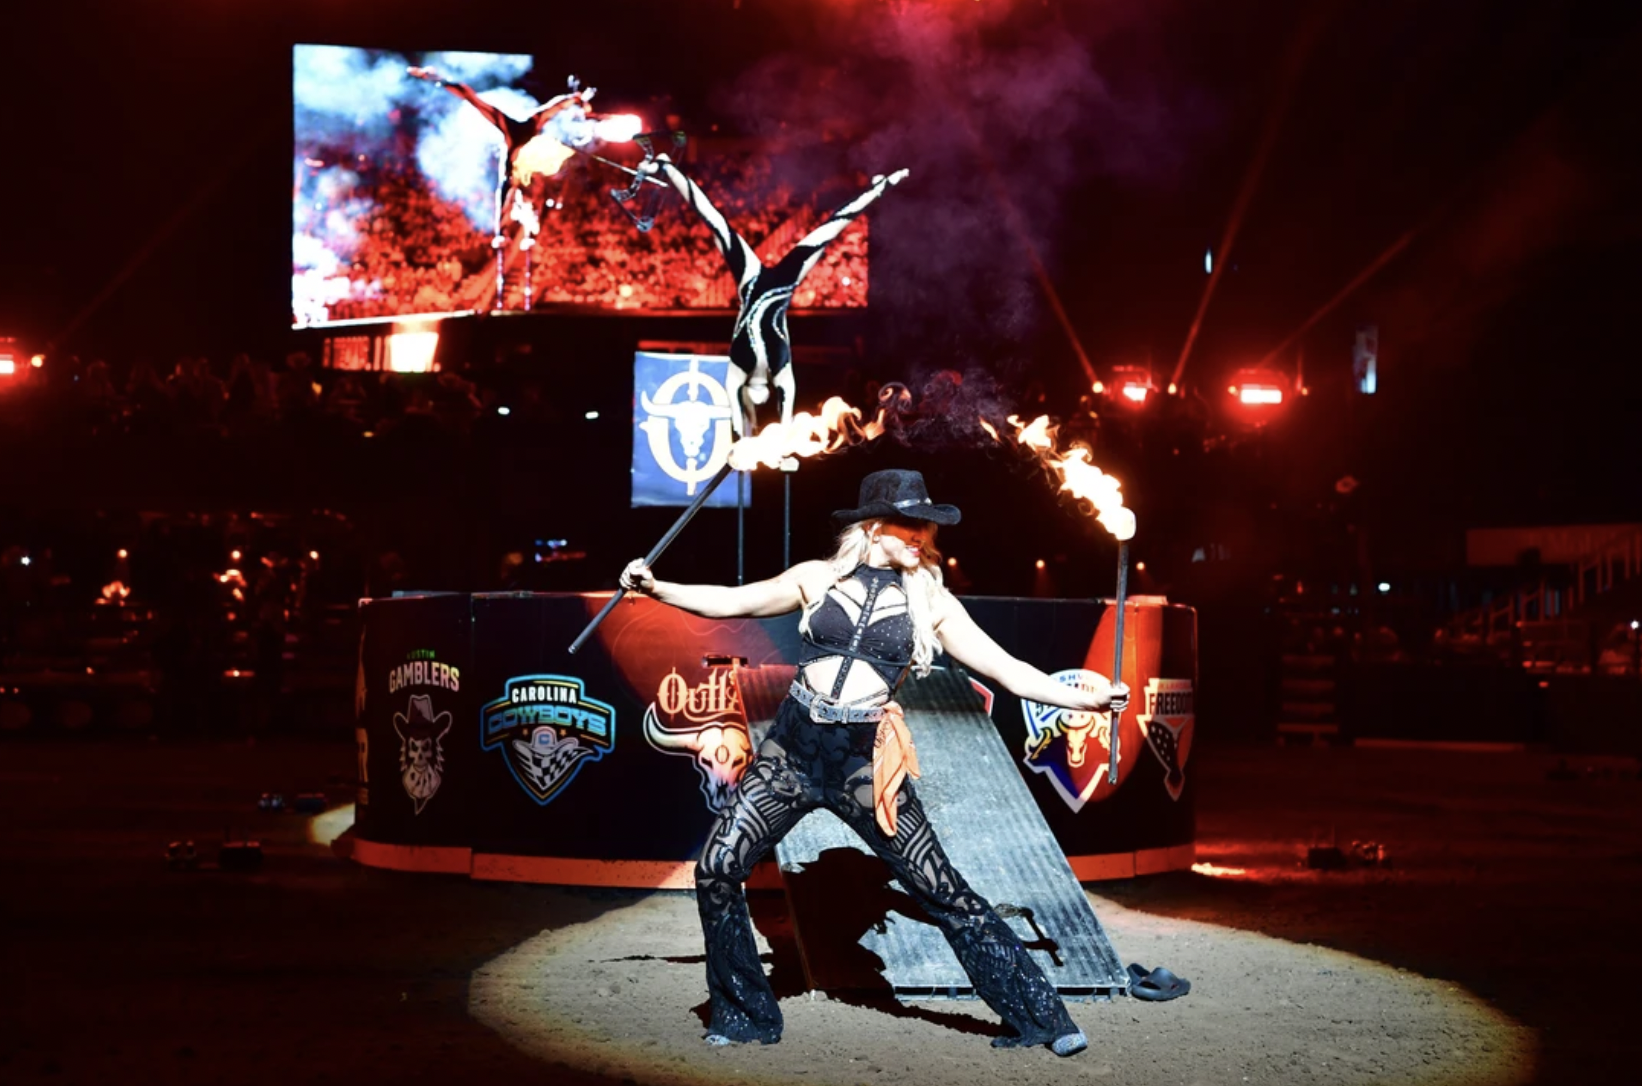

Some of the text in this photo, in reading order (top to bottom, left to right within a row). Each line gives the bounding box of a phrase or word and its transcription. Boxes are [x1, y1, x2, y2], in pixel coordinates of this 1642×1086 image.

[389, 661, 460, 693] GAMBLERS
[511, 686, 577, 703] CAROLINA
[488, 704, 606, 736] COWBOYS
